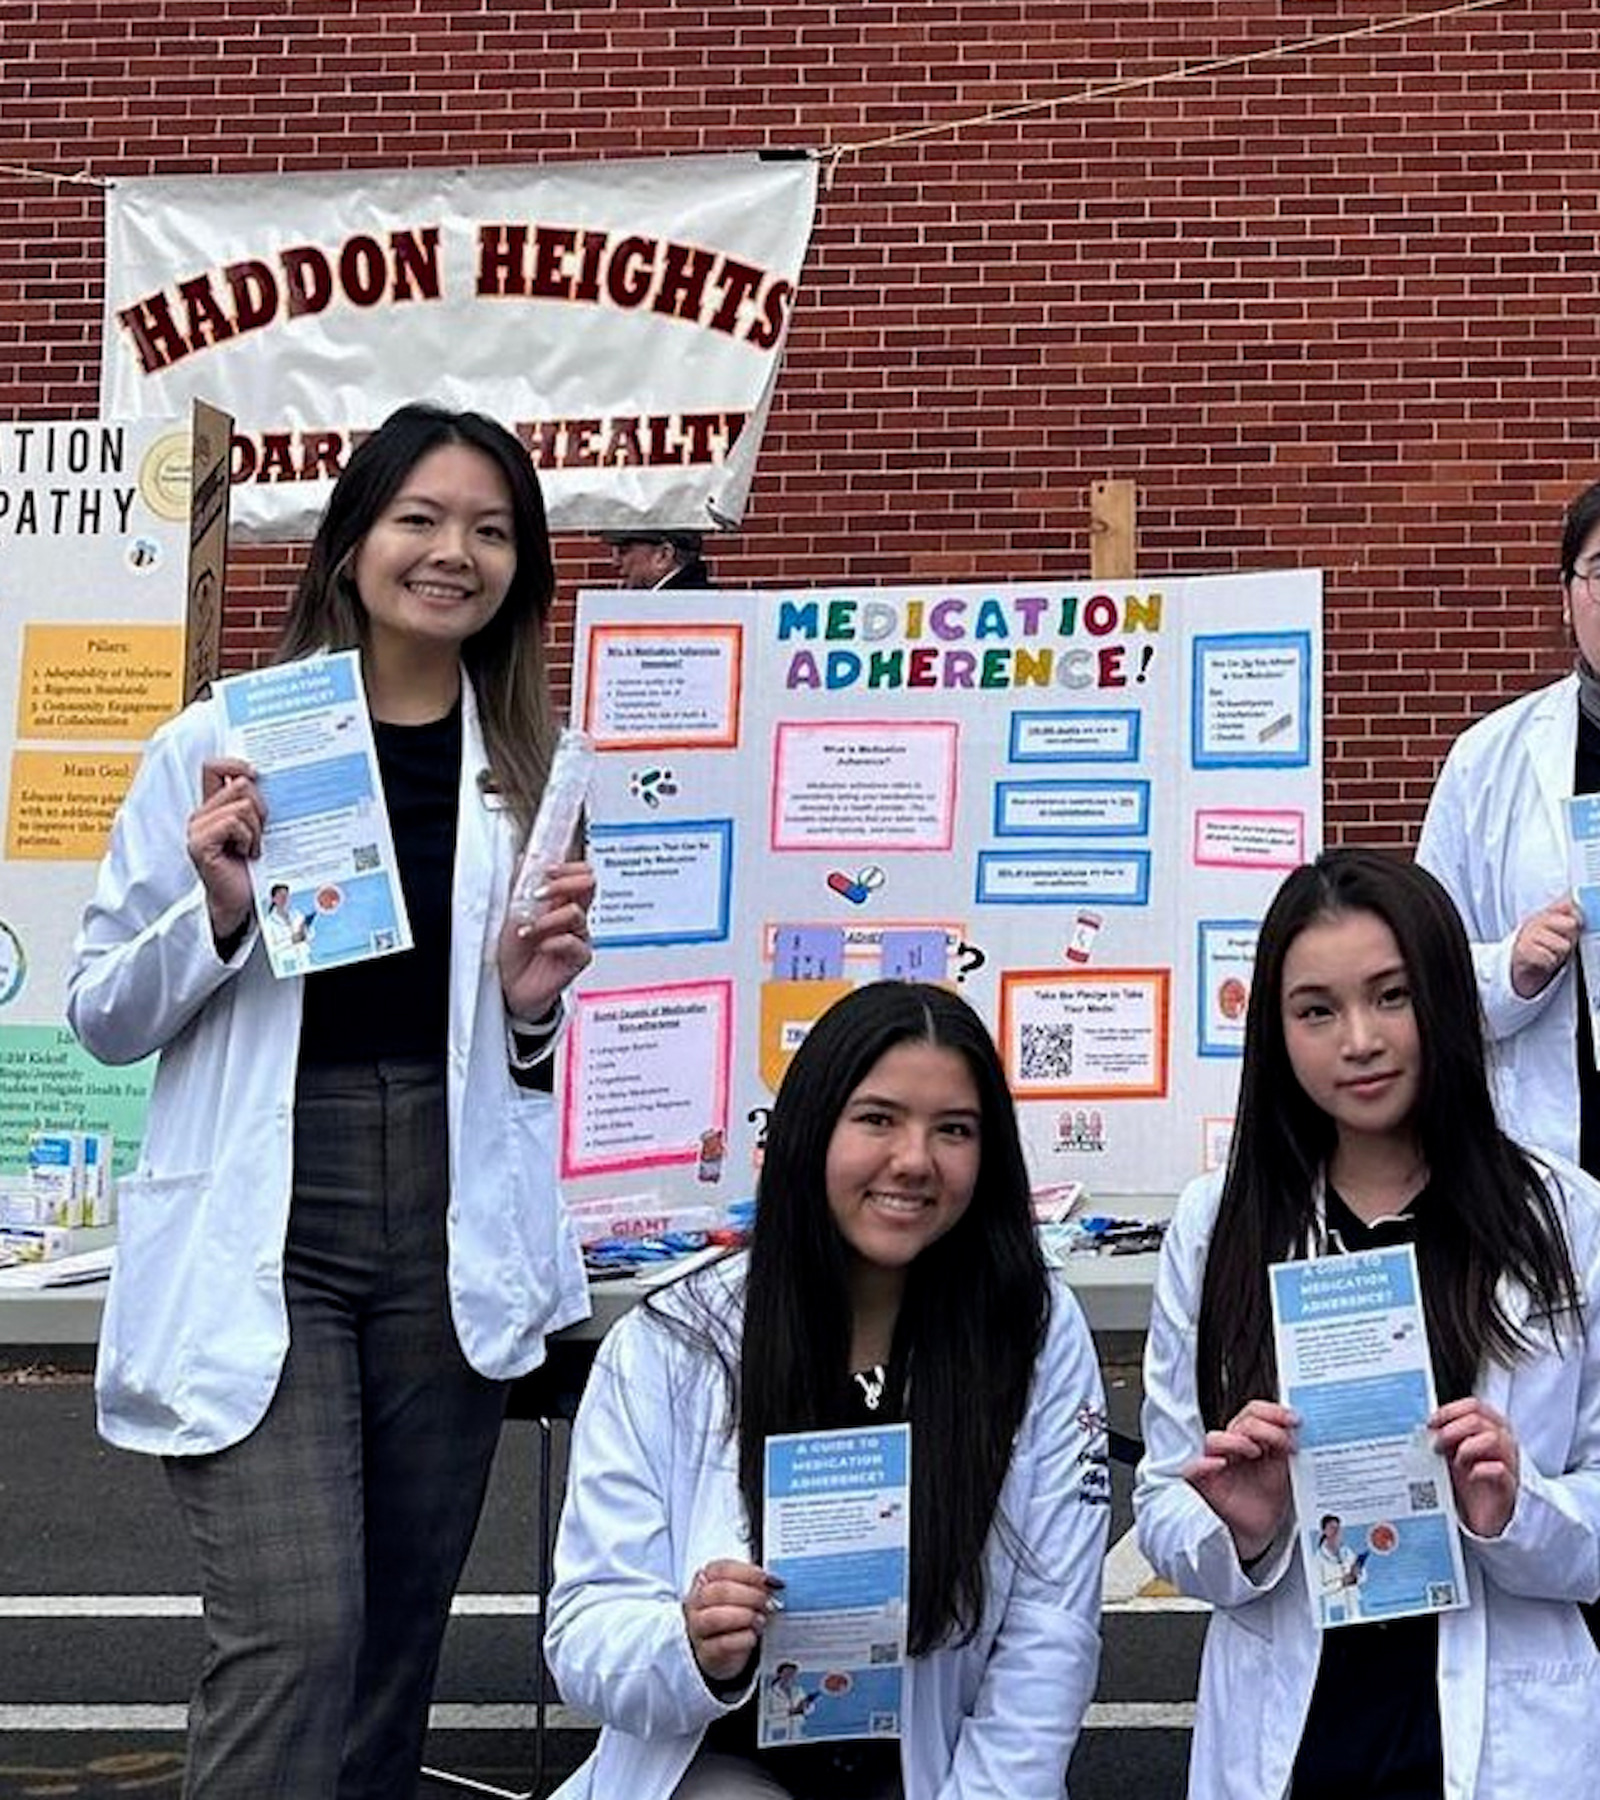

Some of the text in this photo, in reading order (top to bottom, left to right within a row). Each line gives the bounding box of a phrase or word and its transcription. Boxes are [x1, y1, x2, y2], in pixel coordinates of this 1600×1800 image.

[116, 225, 794, 374] HADDON HEIGHTS
[230, 431, 380, 484] OAR
[778, 594, 1163, 642] MEDICATION
[786, 645, 1155, 690] ADHERENCE!
[1300, 1273, 1389, 1295] MEDICATION
[792, 1454, 884, 1472] MEDICATION
